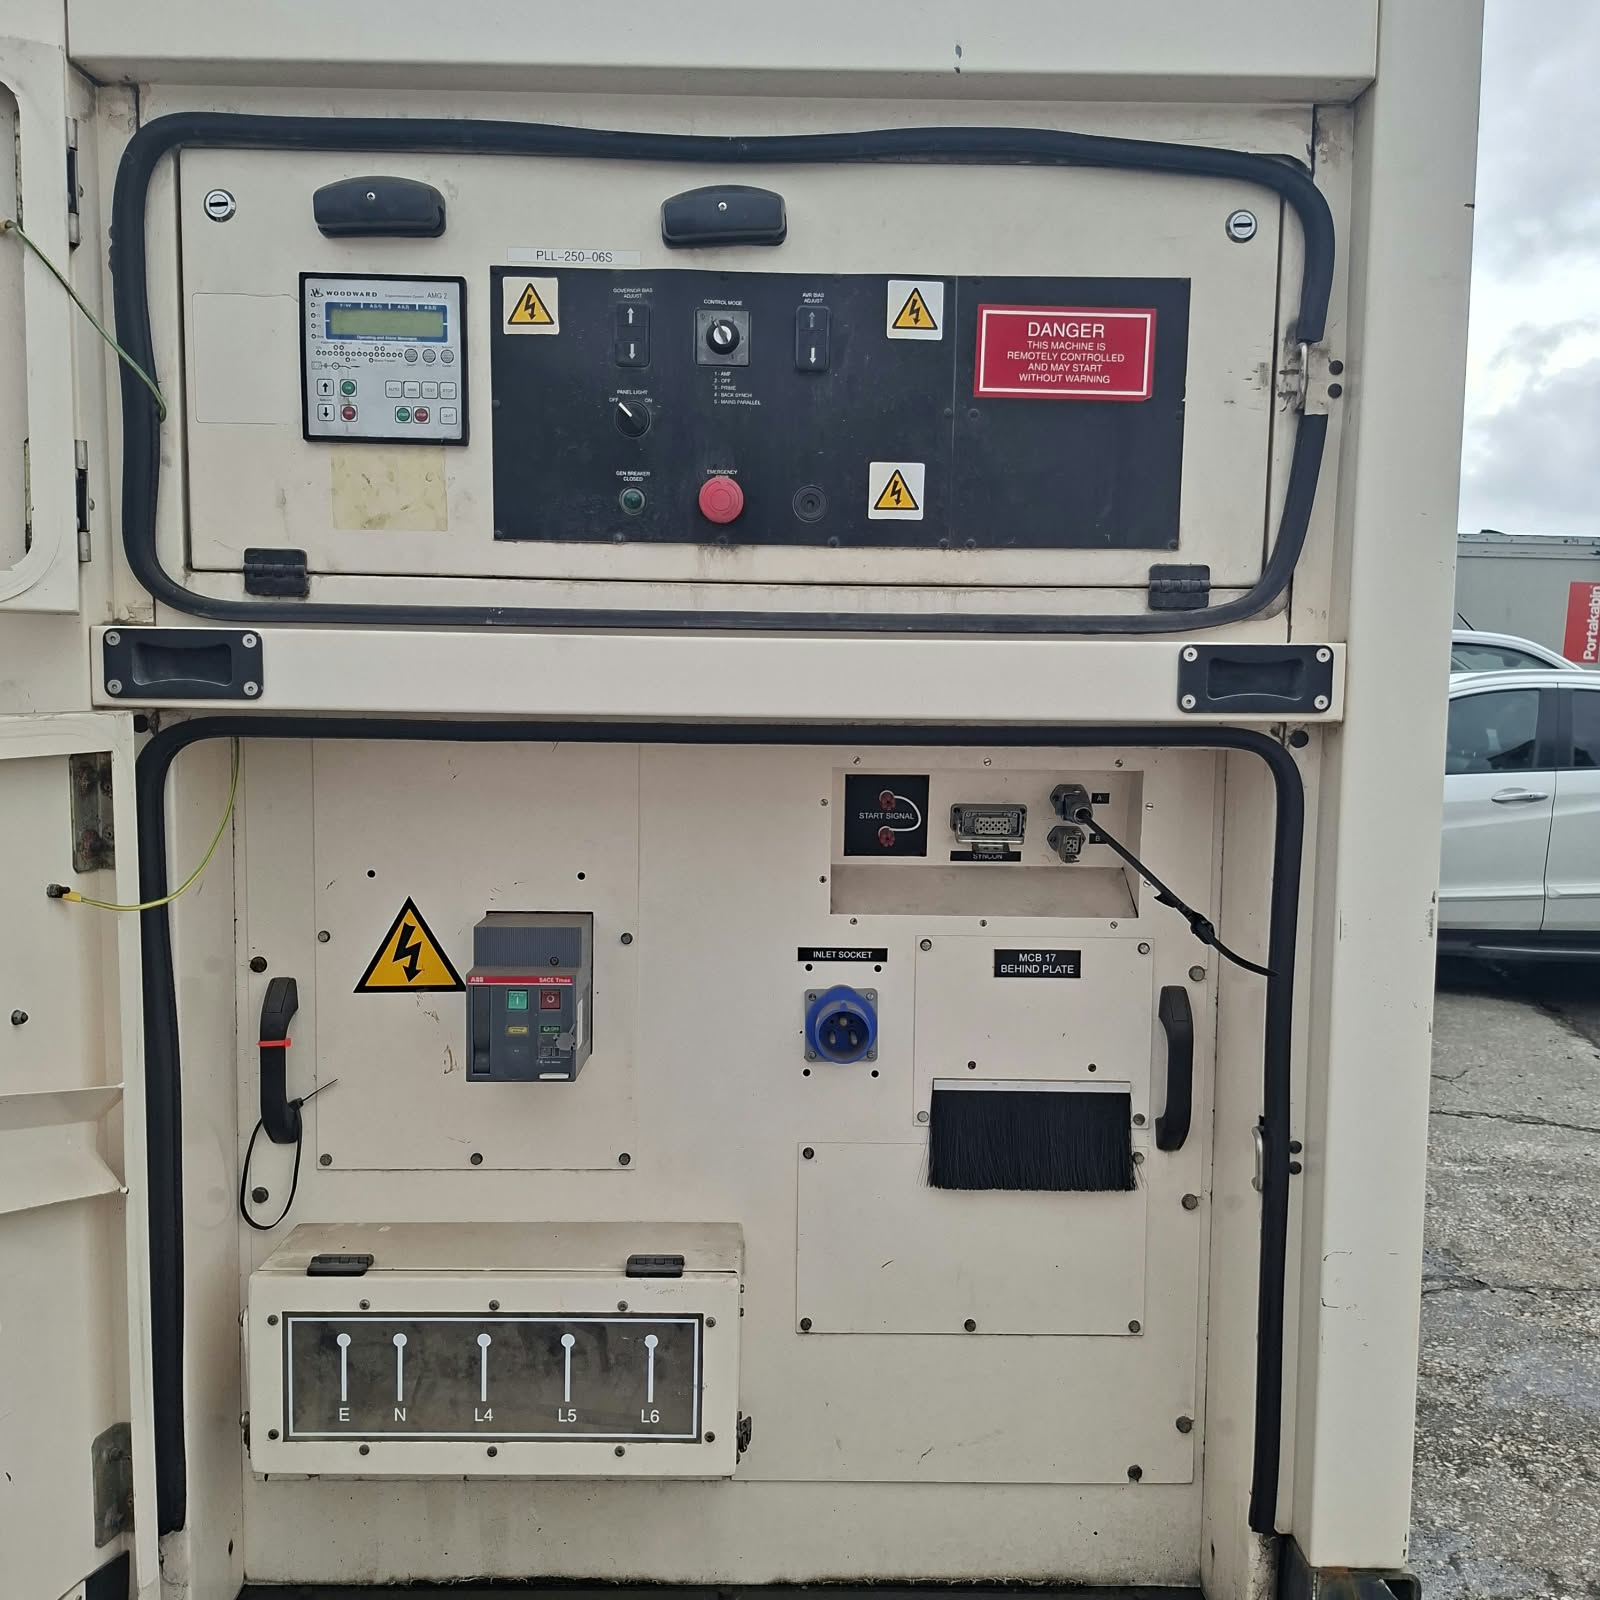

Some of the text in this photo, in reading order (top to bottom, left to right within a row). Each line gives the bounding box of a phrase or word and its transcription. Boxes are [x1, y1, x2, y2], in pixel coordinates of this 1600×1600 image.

[536, 250, 613, 263] PLL-250-06S
[326, 290, 378, 298] WOODWARD
[443, 292, 448, 300] 2
[1028, 322, 1105, 338] DANGER
[1027, 341, 1048, 350] THIS
[1050, 342, 1094, 350] MACHINE
[1007, 352, 1124, 362] REMOTELY CONTROLLED
[1028, 364, 1102, 372] AND MAY START
[1019, 374, 1110, 384] WITHOUT WARNING
[1583, 586, 1600, 660] Portakabin
[813, 951, 872, 960] INLET SOCKET
[1018, 954, 1056, 962] MCB 17
[1000, 964, 1074, 974] BEHIND PLATE
[338, 1408, 350, 1421] E
[394, 1408, 406, 1422] N
[474, 1408, 493, 1422] L4
[558, 1408, 577, 1422] L5
[640, 1409, 660, 1422] L6
